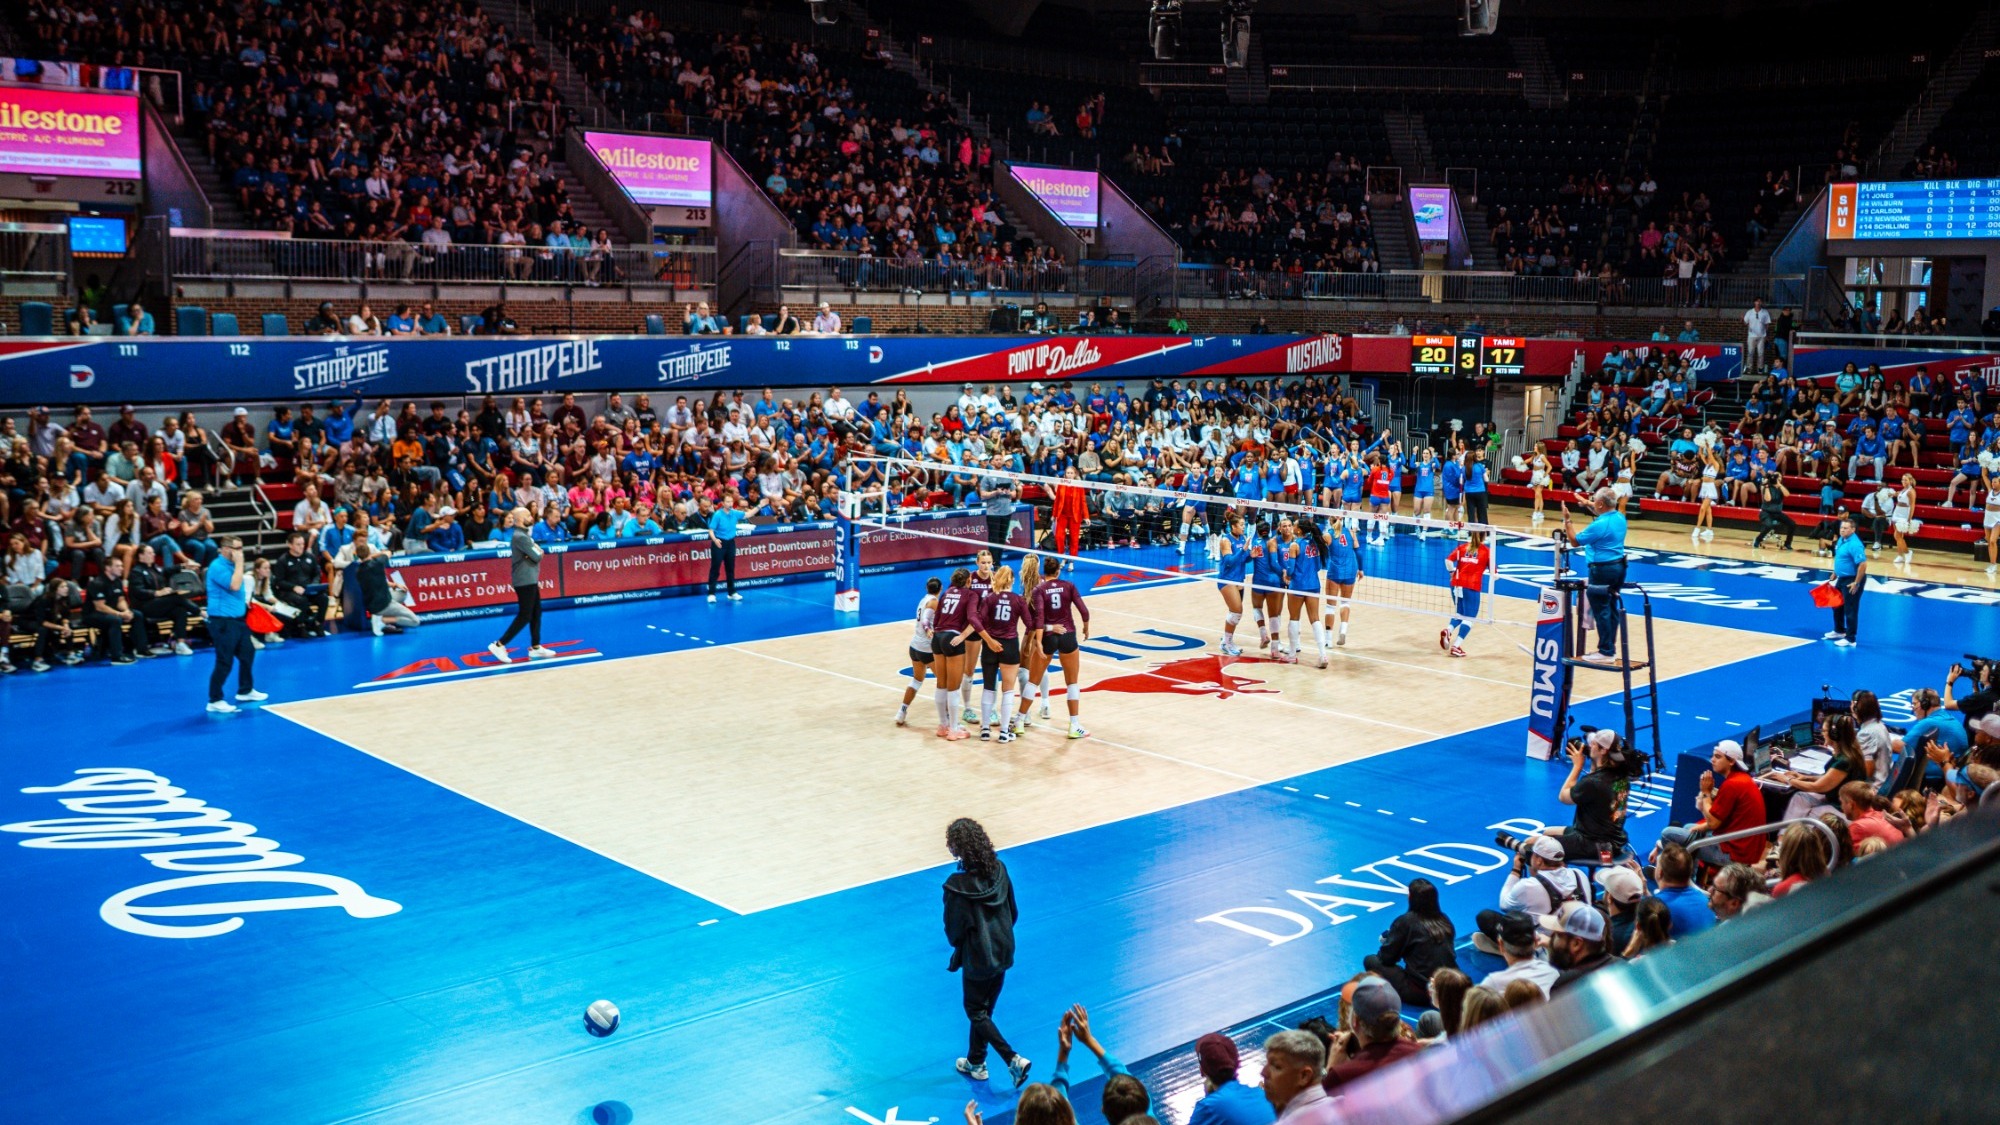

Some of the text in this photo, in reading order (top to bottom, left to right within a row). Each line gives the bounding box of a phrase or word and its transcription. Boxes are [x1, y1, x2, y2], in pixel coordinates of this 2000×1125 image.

[0, 102, 122, 134] ilestone
[598, 147, 700, 172] Milestone
[105, 181, 136, 196] 212
[1861, 184, 1887, 192] PLAYER
[1946, 181, 1960, 189] BLK
[1967, 180, 1981, 188] DIG
[686, 209, 706, 220] 213
[119, 345, 138, 356] 111
[230, 344, 250, 356] 112
[690, 343, 701, 353] THE
[776, 341, 790, 350] 112
[846, 341, 858, 349] 113
[1194, 339, 1203, 347] 113
[1232, 339, 1241, 347] 114
[1462, 339, 1476, 348] SET
[334, 345, 350, 358] THE
[1008, 338, 1101, 376] PONY UP Dallas
[1287, 336, 1342, 373] MUSTANGS
[1421, 347, 1446, 363] 20
[1491, 348, 1515, 364] 17
[1724, 347, 1737, 356] 115
[465, 340, 602, 394] STAMPEDE
[658, 346, 732, 382] STAMPEDE
[1461, 353, 1475, 369] 3
[293, 349, 389, 390] STAMPEDE
[646, 537, 664, 545] UTSW
[691, 533, 709, 541] UTSW
[873, 534, 887, 543] our
[952, 524, 988, 537] package.
[1339, 535, 1348, 547] 4
[497, 550, 512, 558] UTS
[549, 545, 568, 553] UTSW
[574, 560, 602, 573] Pony
[605, 558, 620, 570] up
[622, 554, 646, 567] with
[648, 552, 677, 565] Pride
[679, 551, 689, 562] in
[691, 549, 712, 560] Dall
[736, 543, 767, 557] arriott
[769, 538, 820, 553] Downtown
[836, 526, 845, 581] SMU
[444, 554, 465, 563] UTSW
[751, 560, 770, 572] Use
[771, 557, 803, 569] Promo
[805, 554, 830, 565] Code
[418, 572, 488, 588] MARRIOTT
[419, 579, 554, 602] DALLAS DOWNWN
[624, 591, 644, 599] Medical
[941, 598, 960, 615] 37
[1051, 593, 1062, 609] 9
[417, 607, 503, 622] outhwestern Medical Center
[995, 604, 1012, 621] 16
[1531, 637, 1559, 719] SMU
[1195, 842, 1509, 947] DAVID
